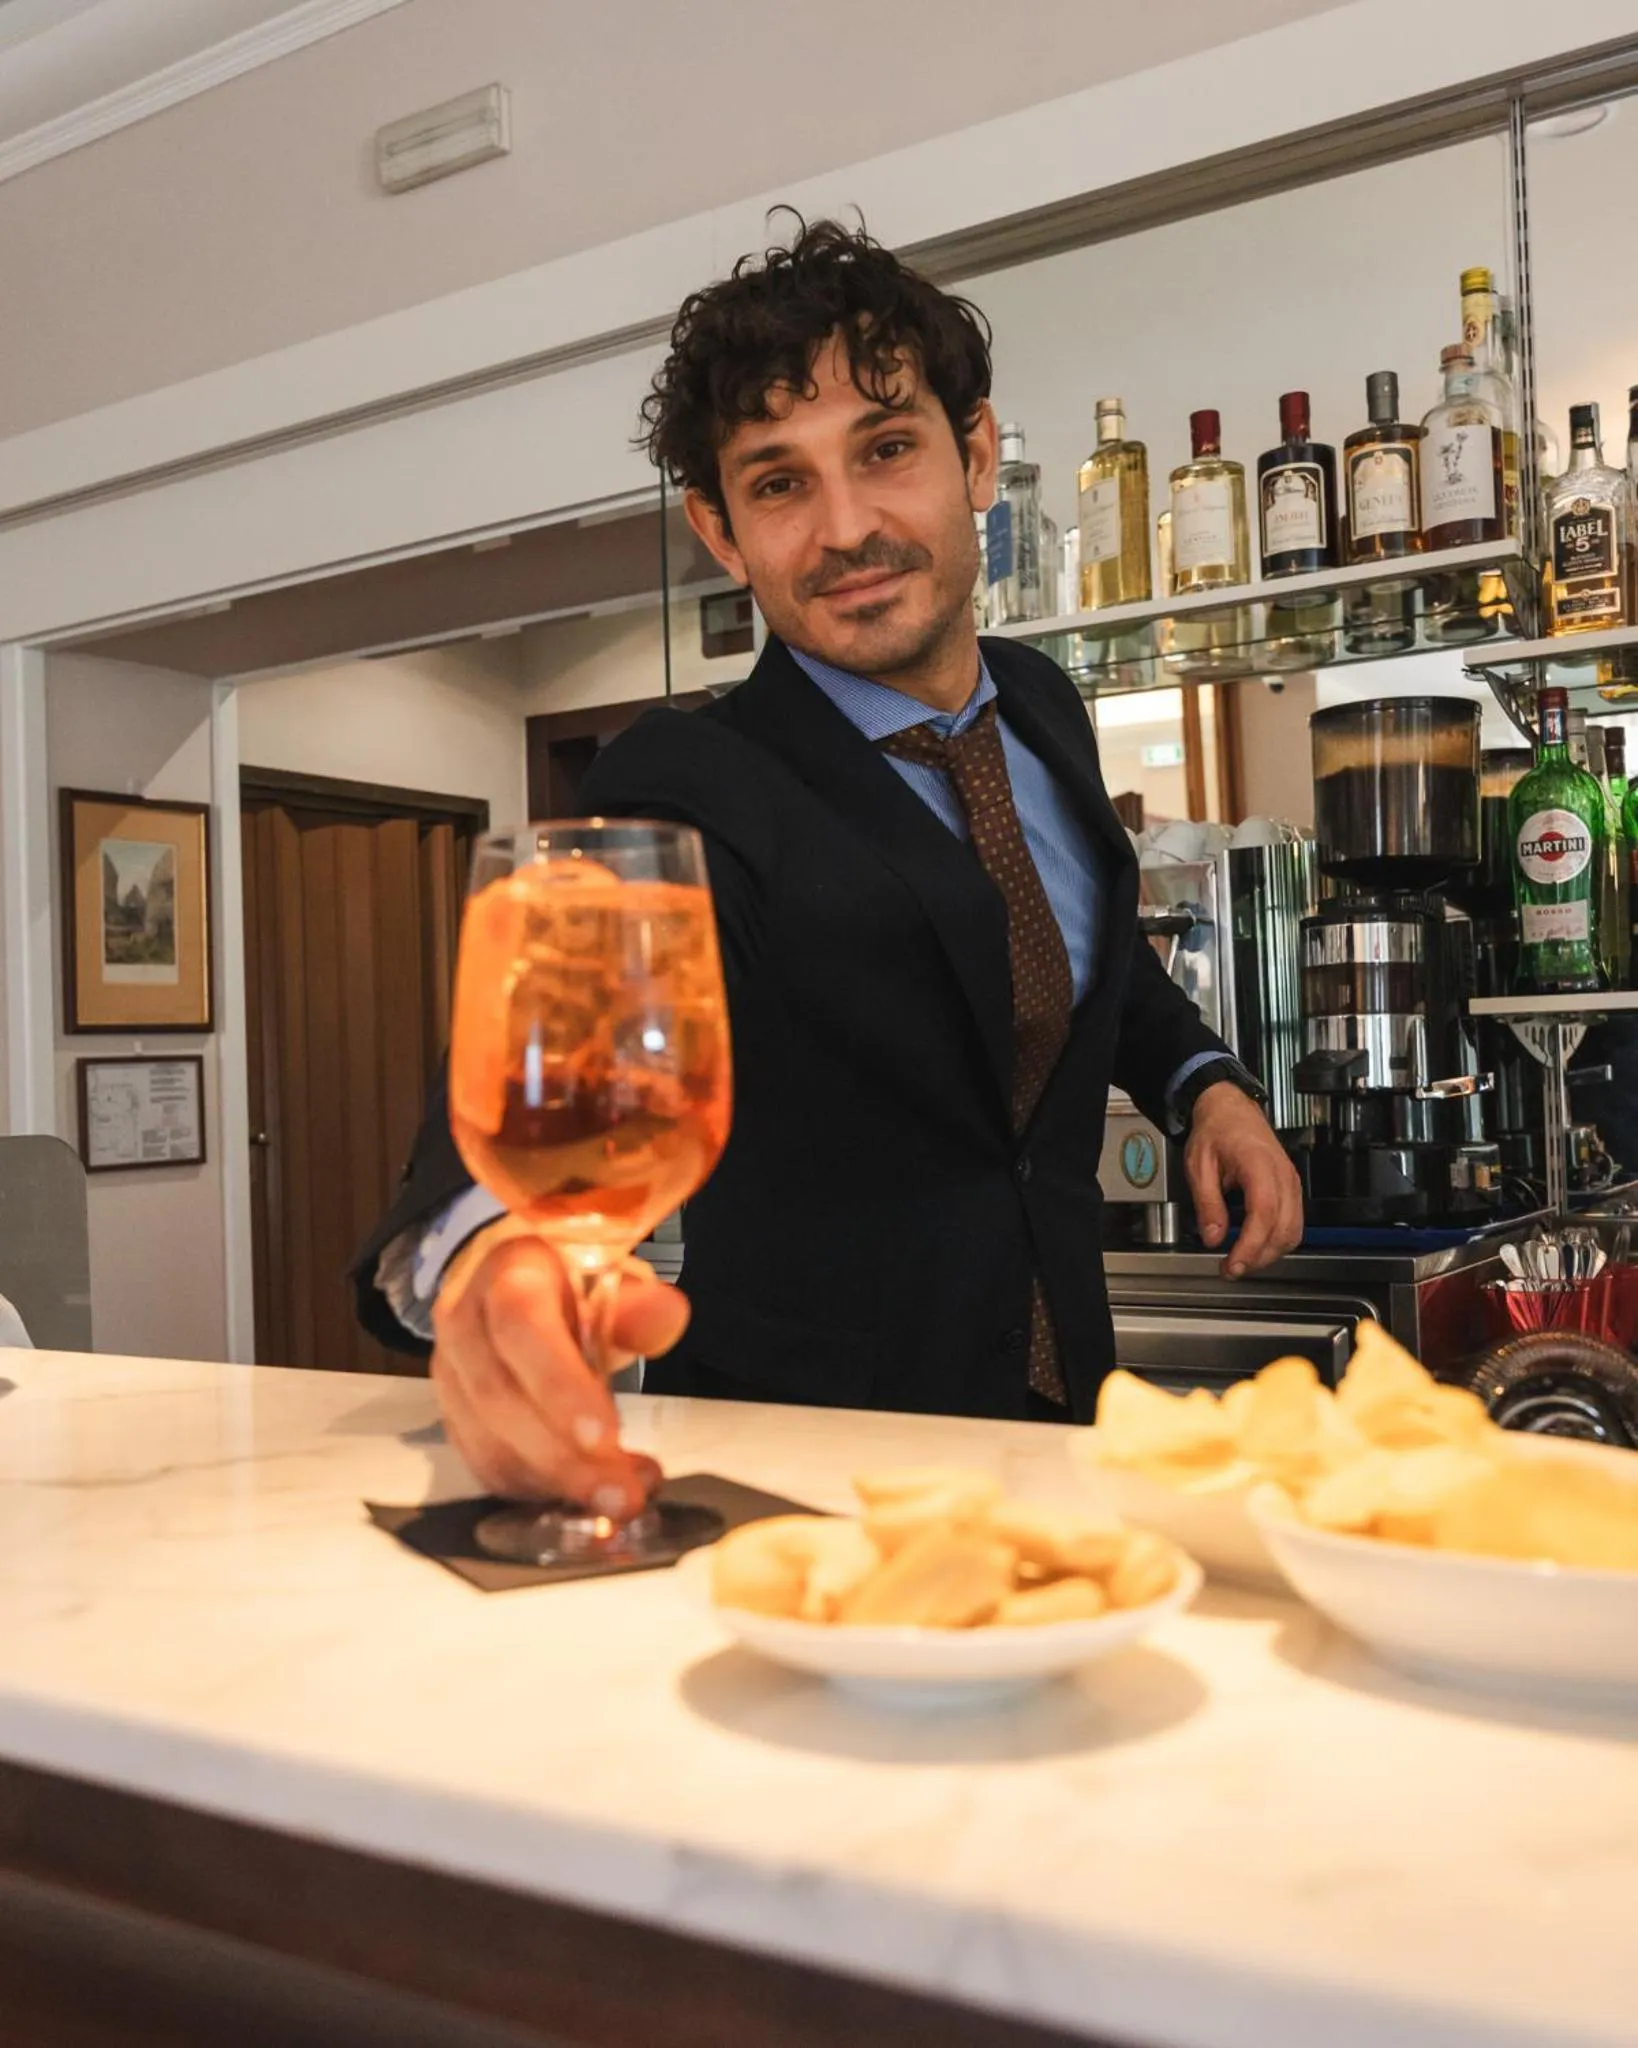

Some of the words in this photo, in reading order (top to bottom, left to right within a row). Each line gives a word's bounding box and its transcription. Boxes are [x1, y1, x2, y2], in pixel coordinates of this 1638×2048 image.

[1560, 519, 1608, 543] LABEL
[1575, 537, 1591, 552] 5
[1523, 838, 1584, 856] MARTINI
